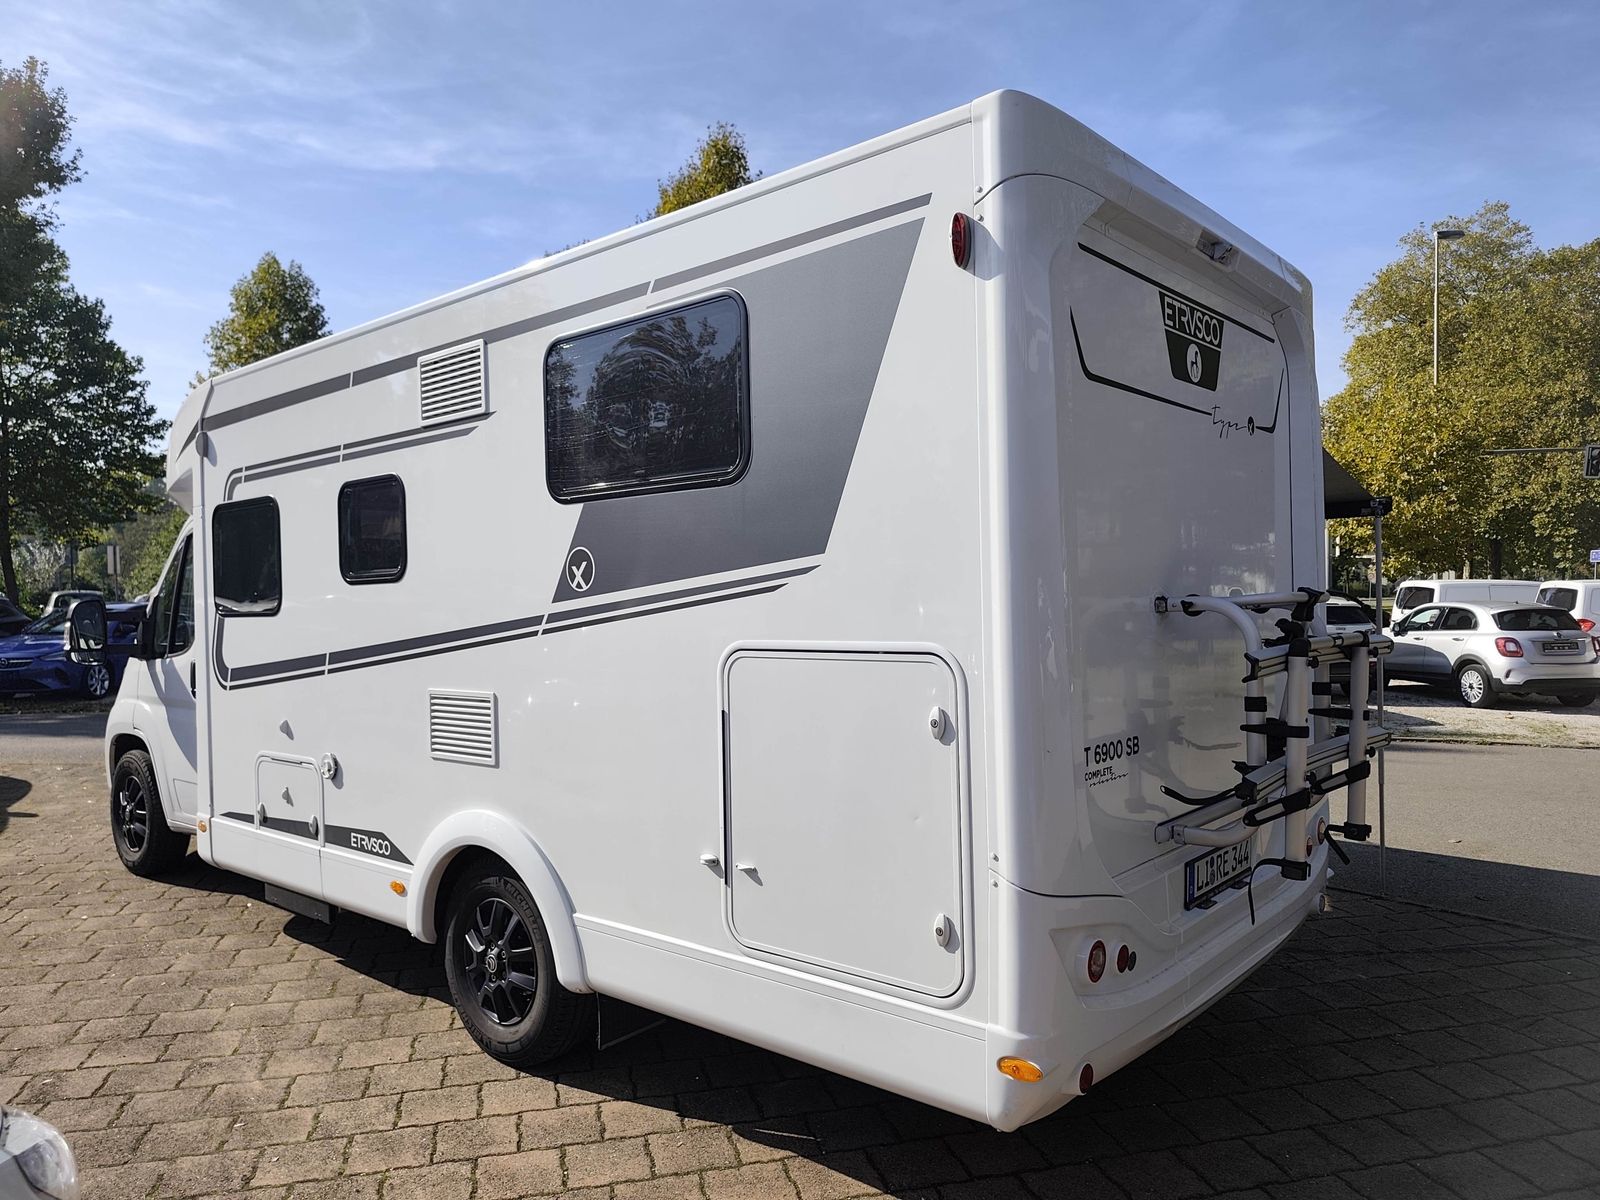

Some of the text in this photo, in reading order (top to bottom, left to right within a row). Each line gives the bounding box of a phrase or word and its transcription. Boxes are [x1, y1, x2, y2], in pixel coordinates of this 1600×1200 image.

[1083, 735, 1140, 767] T 6900 SB
[1084, 765, 1113, 782] COMPLETE
[1231, 840, 1249, 872] 344
